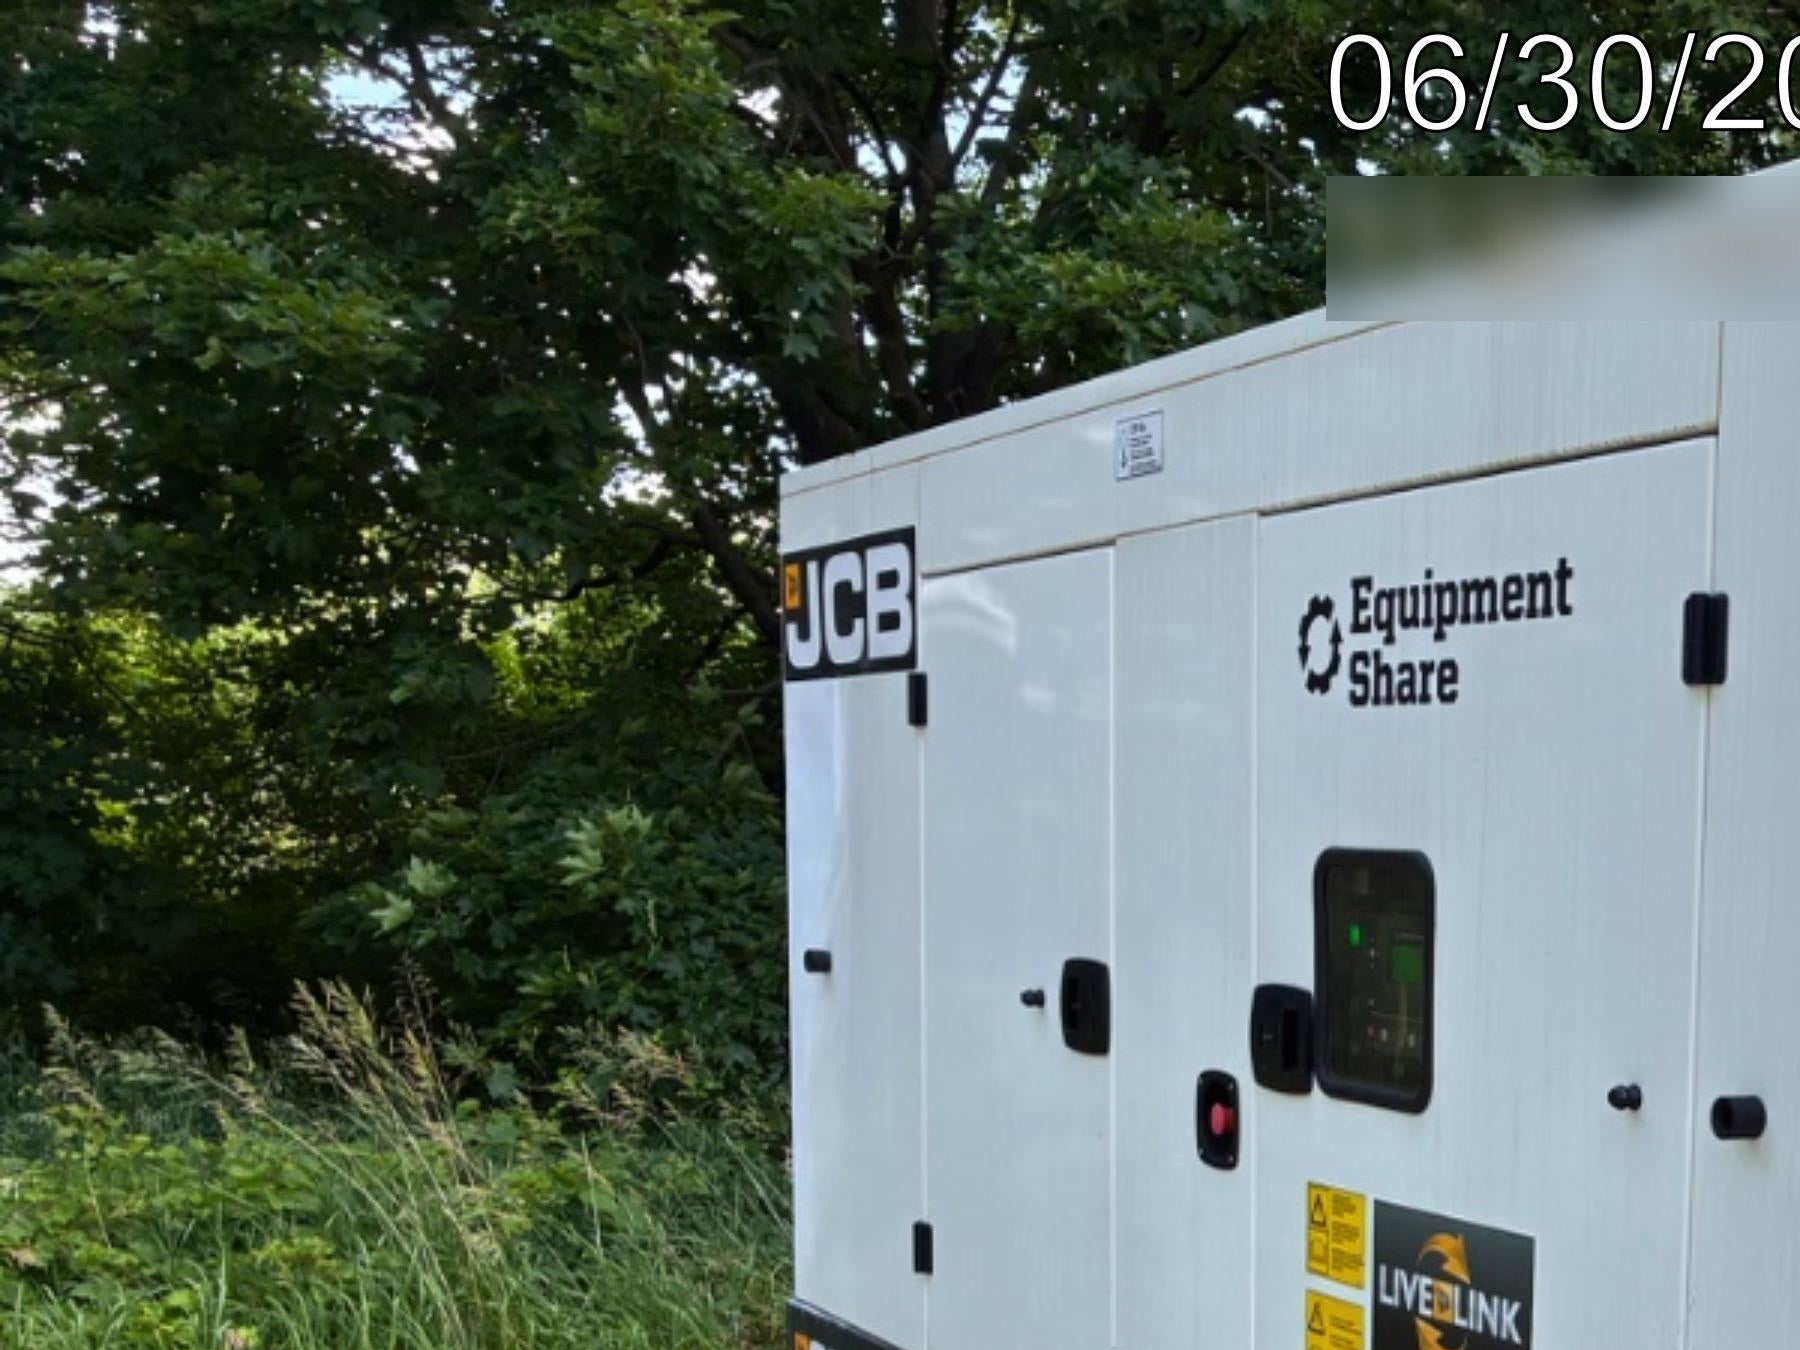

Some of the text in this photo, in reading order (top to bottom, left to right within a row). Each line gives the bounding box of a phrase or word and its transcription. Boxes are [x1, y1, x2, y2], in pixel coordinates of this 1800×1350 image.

[785, 541, 914, 670] JCB
[1350, 557, 1574, 646] Equipment
[1349, 648, 1460, 708] Share
[1378, 1263, 1523, 1346] LIVE LINK
